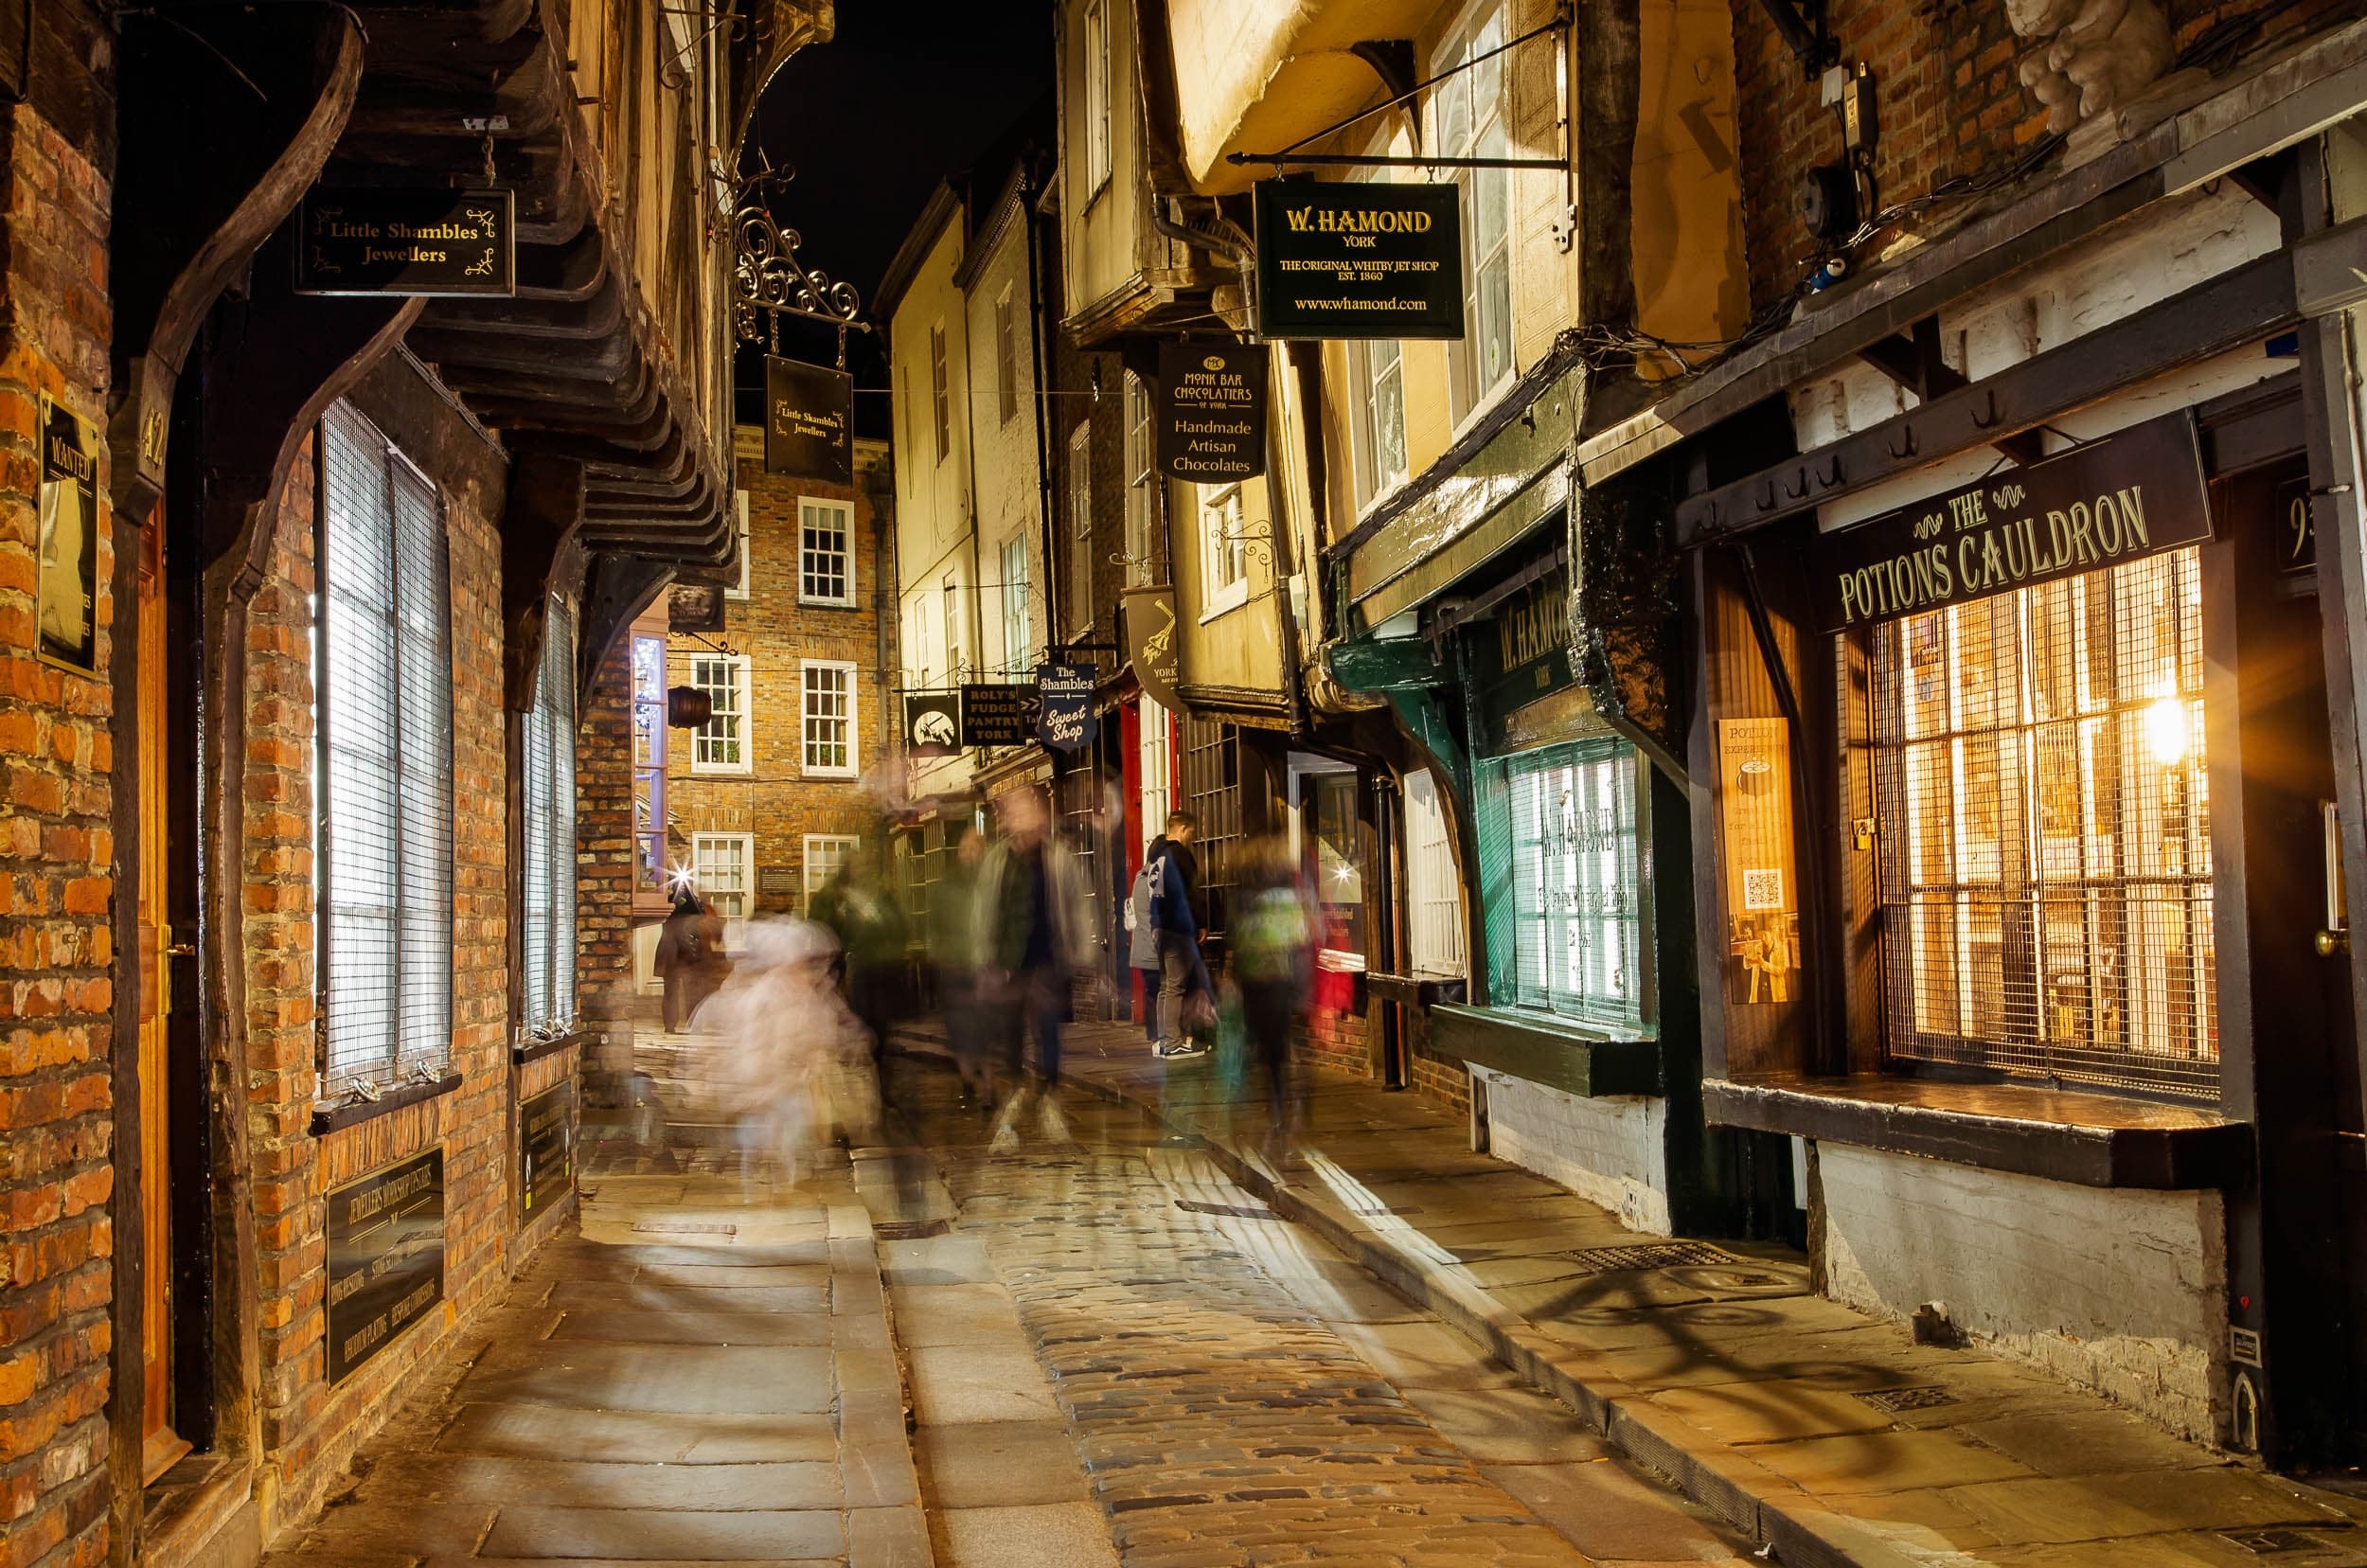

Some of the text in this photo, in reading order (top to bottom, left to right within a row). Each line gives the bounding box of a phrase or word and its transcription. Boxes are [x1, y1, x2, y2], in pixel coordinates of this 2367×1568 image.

[1318, 210, 1432, 233] HAMOND
[331, 223, 478, 240] Little Shambles
[1343, 235, 1377, 247] YORK
[362, 246, 446, 265] Jewellers
[1280, 260, 1439, 273] THE ORIGINAL WHITBY JET SHOP
[1338, 272, 1383, 281] EST. 1860
[1294, 296, 1427, 311] www.whamond.com
[1184, 373, 1242, 386] MONK BAR
[1174, 386, 1252, 401] CHOCOLATIERS
[782, 408, 837, 428] Little Shambles
[794, 423, 826, 437] Jewellers
[1175, 419, 1252, 435] Handmade
[1188, 439, 1237, 454] Artisan
[51, 436, 91, 482] WANTED
[1173, 456, 1251, 472] Chocolates
[1949, 489, 1984, 531] THE
[1839, 485, 2151, 624] POTIONS CAULDRON
[1056, 667, 1076, 678] The
[1040, 677, 1094, 690] Shambles
[970, 690, 1016, 701] ROLY'S
[970, 704, 1016, 714] FUDGE
[1046, 704, 1087, 727] Sweet
[968, 717, 1020, 727] PANTRY
[976, 729, 1012, 739] YORK
[1052, 723, 1083, 742] Shop
